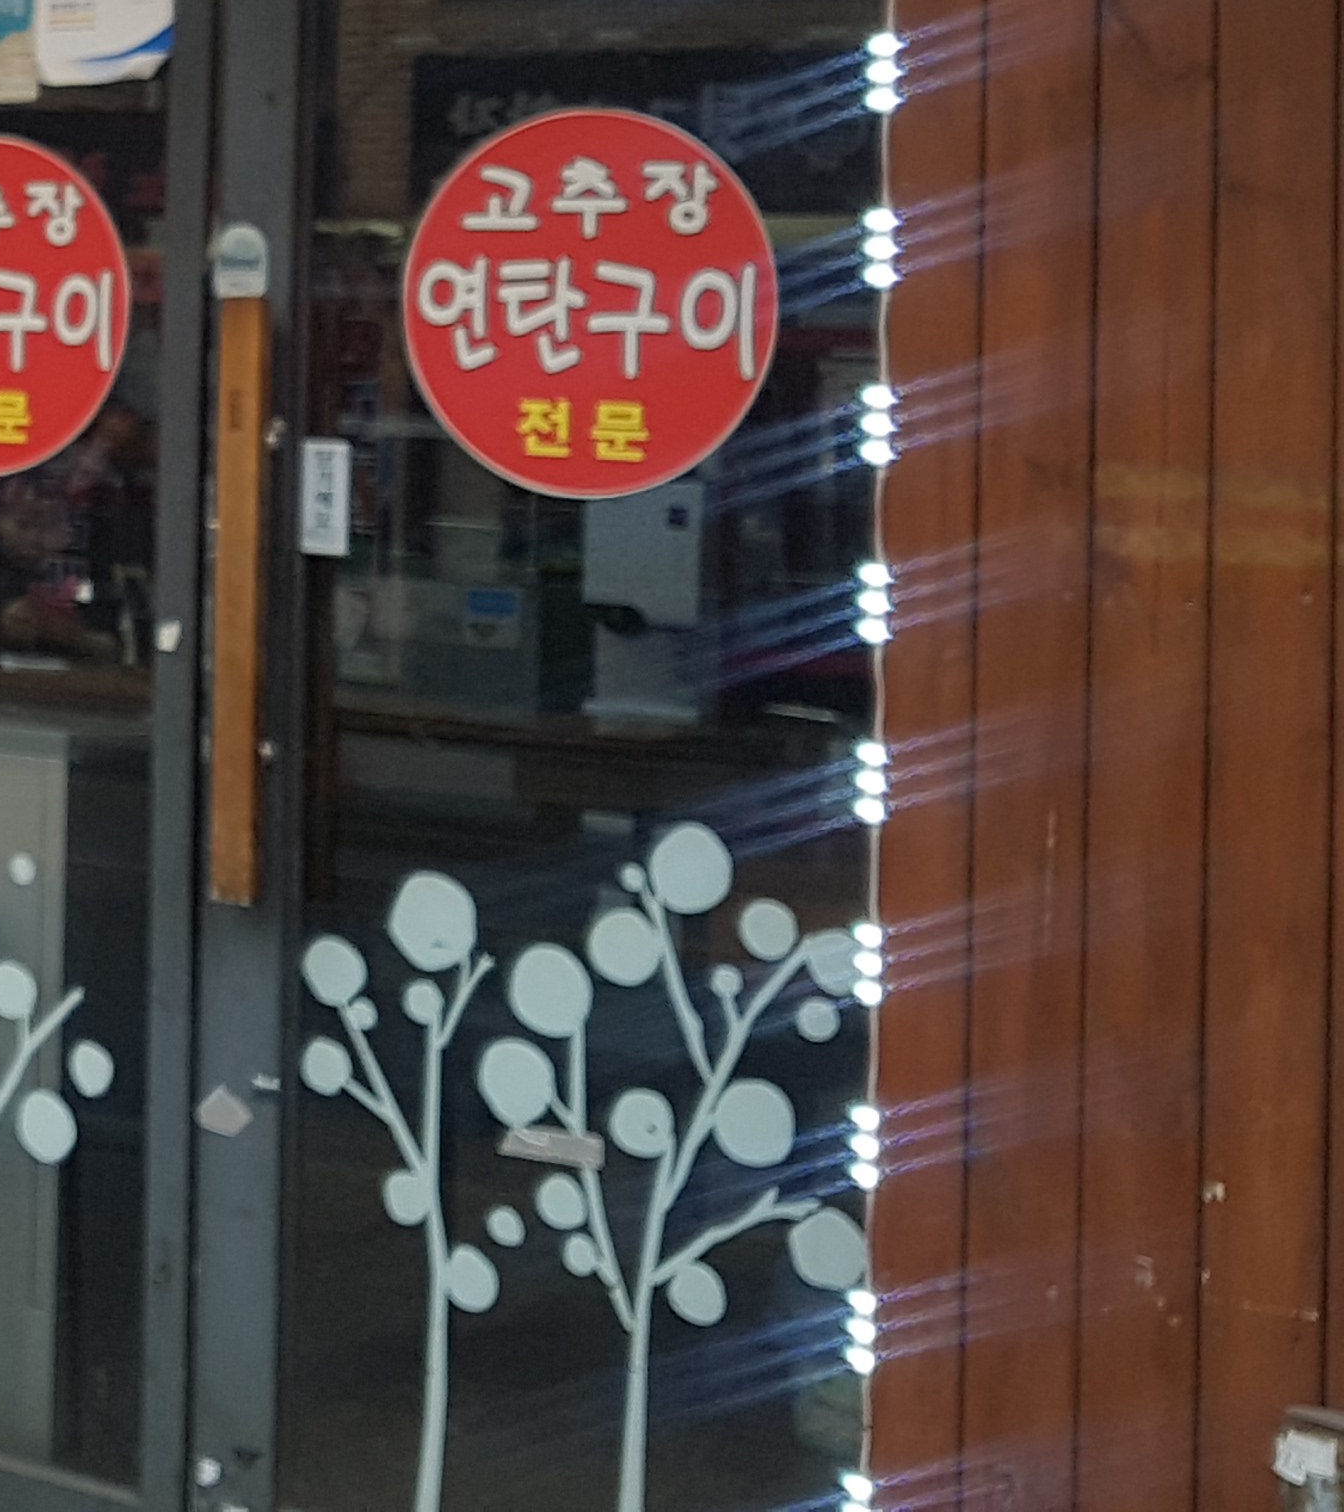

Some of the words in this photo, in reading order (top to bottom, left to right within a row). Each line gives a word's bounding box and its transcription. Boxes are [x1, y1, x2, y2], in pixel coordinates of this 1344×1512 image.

[460, 155, 718, 239] 고추장
[416, 255, 758, 381] 연탄구이
[516, 397, 652, 463] 전문
